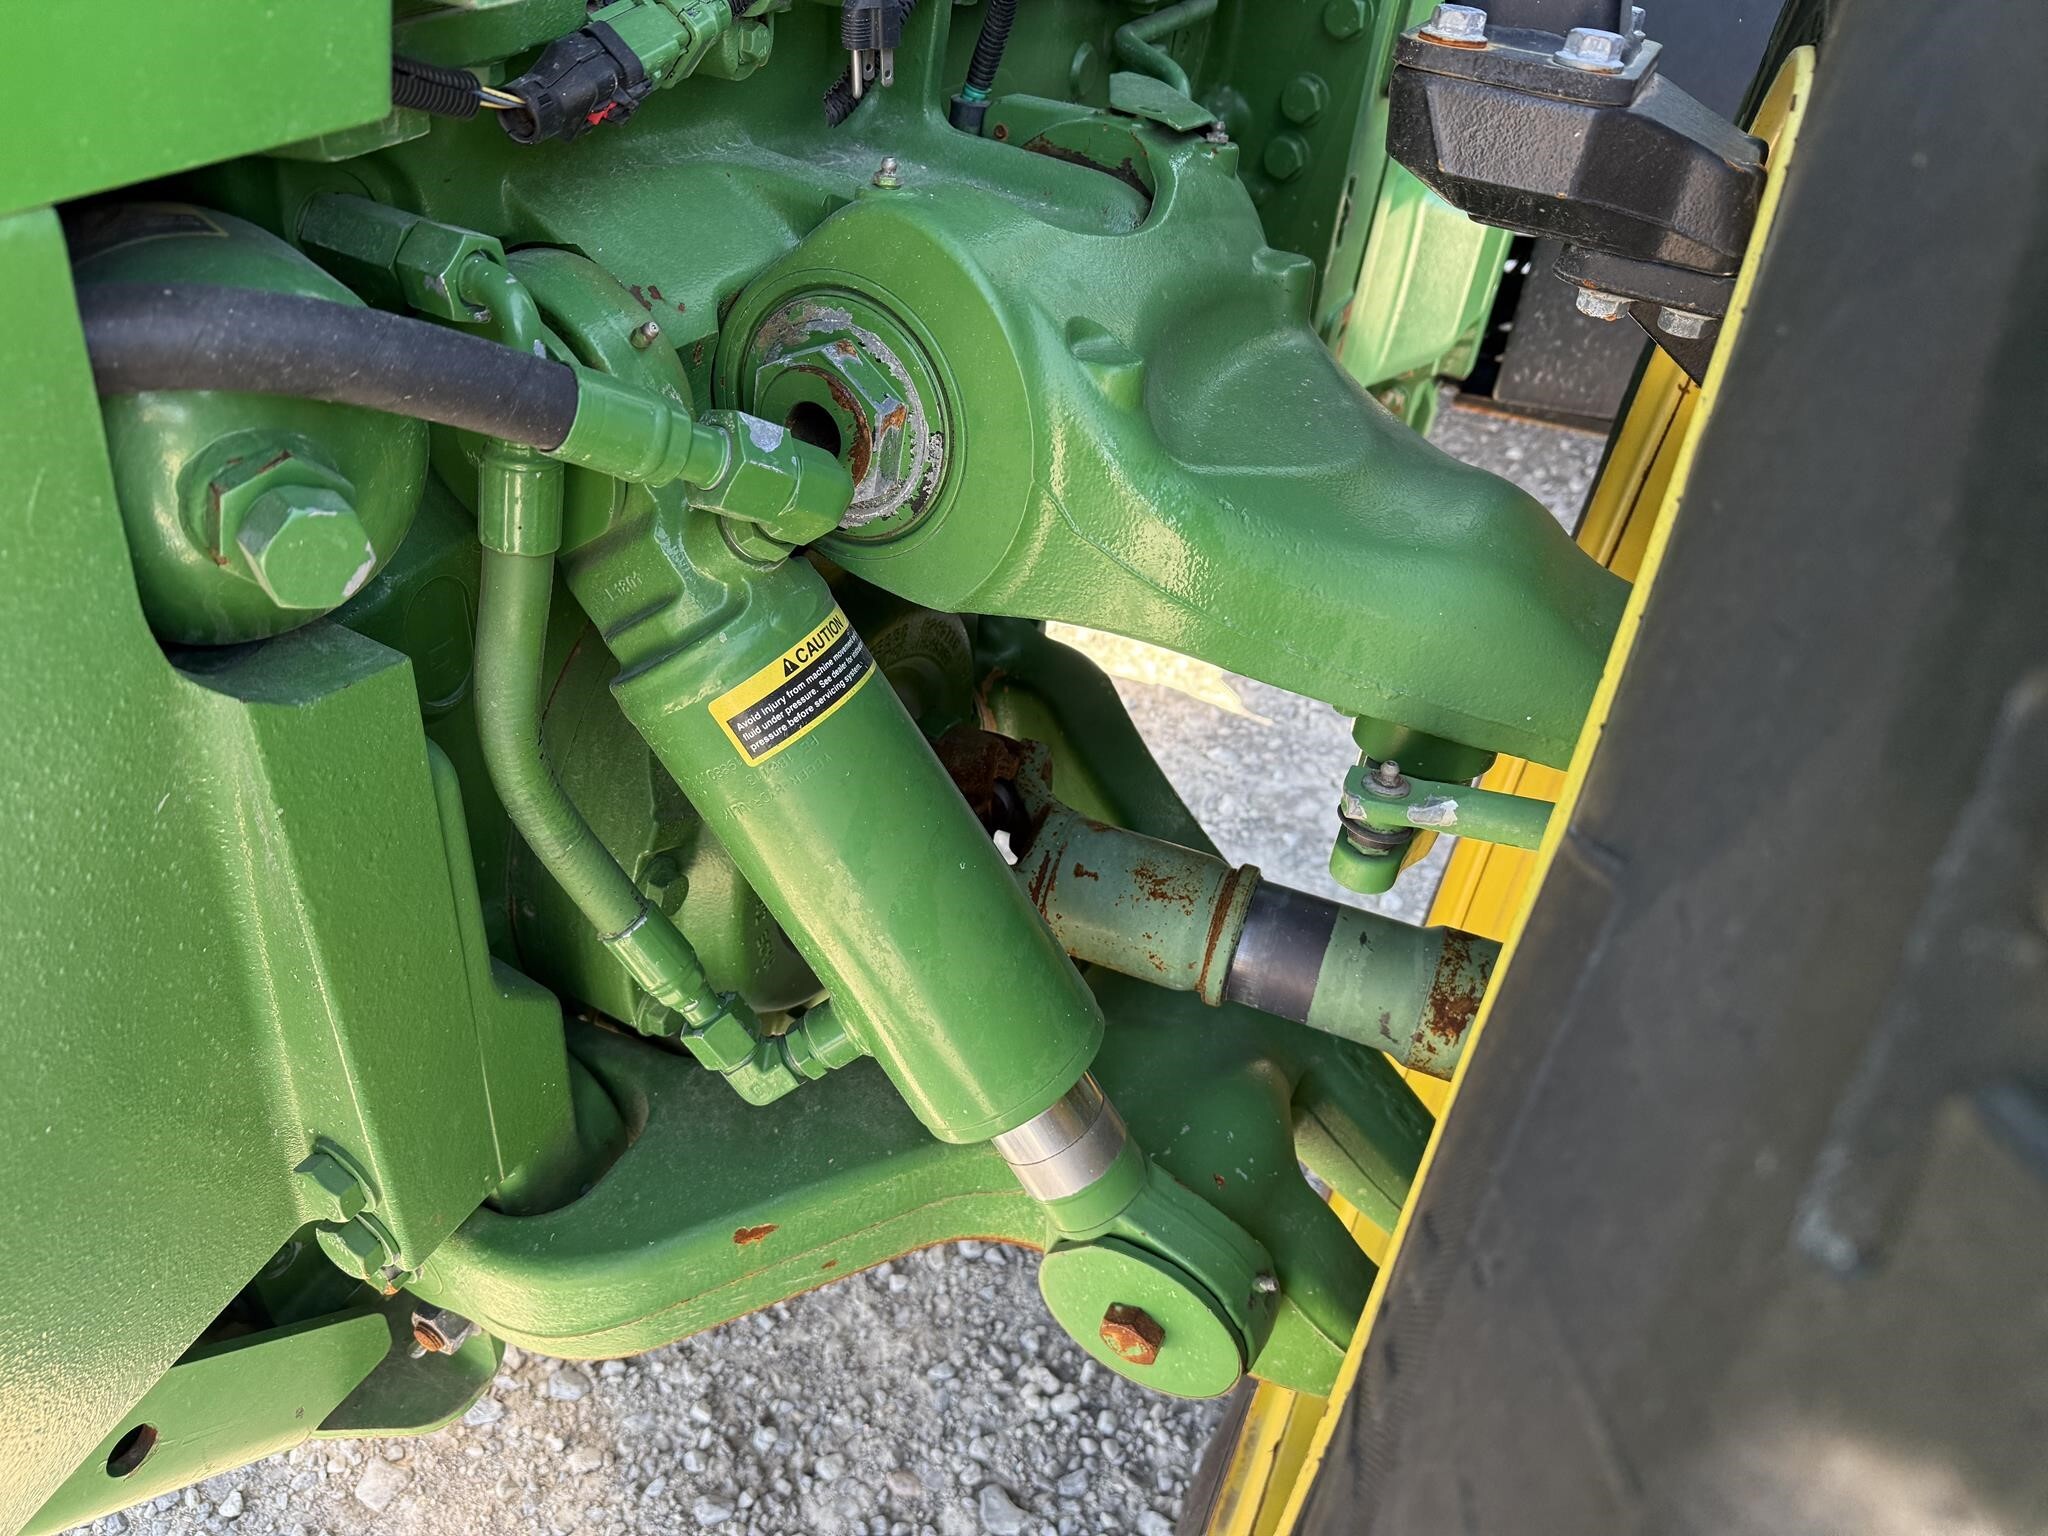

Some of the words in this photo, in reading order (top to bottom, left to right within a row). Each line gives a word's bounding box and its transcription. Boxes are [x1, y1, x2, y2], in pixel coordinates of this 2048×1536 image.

[796, 616, 844, 663] CAUTION
[737, 712, 761, 731] Avoid
[786, 681, 805, 698] from
[806, 660, 833, 684] machine
[742, 728, 762, 741] fluid
[763, 712, 785, 730] under
[785, 689, 819, 716] pressure.
[819, 677, 832, 688] See
[831, 661, 848, 678] dealer
[750, 725, 788, 752] pressure
[788, 705, 815, 726] before
[815, 679, 846, 708] servicing
[844, 663, 862, 683] system.
